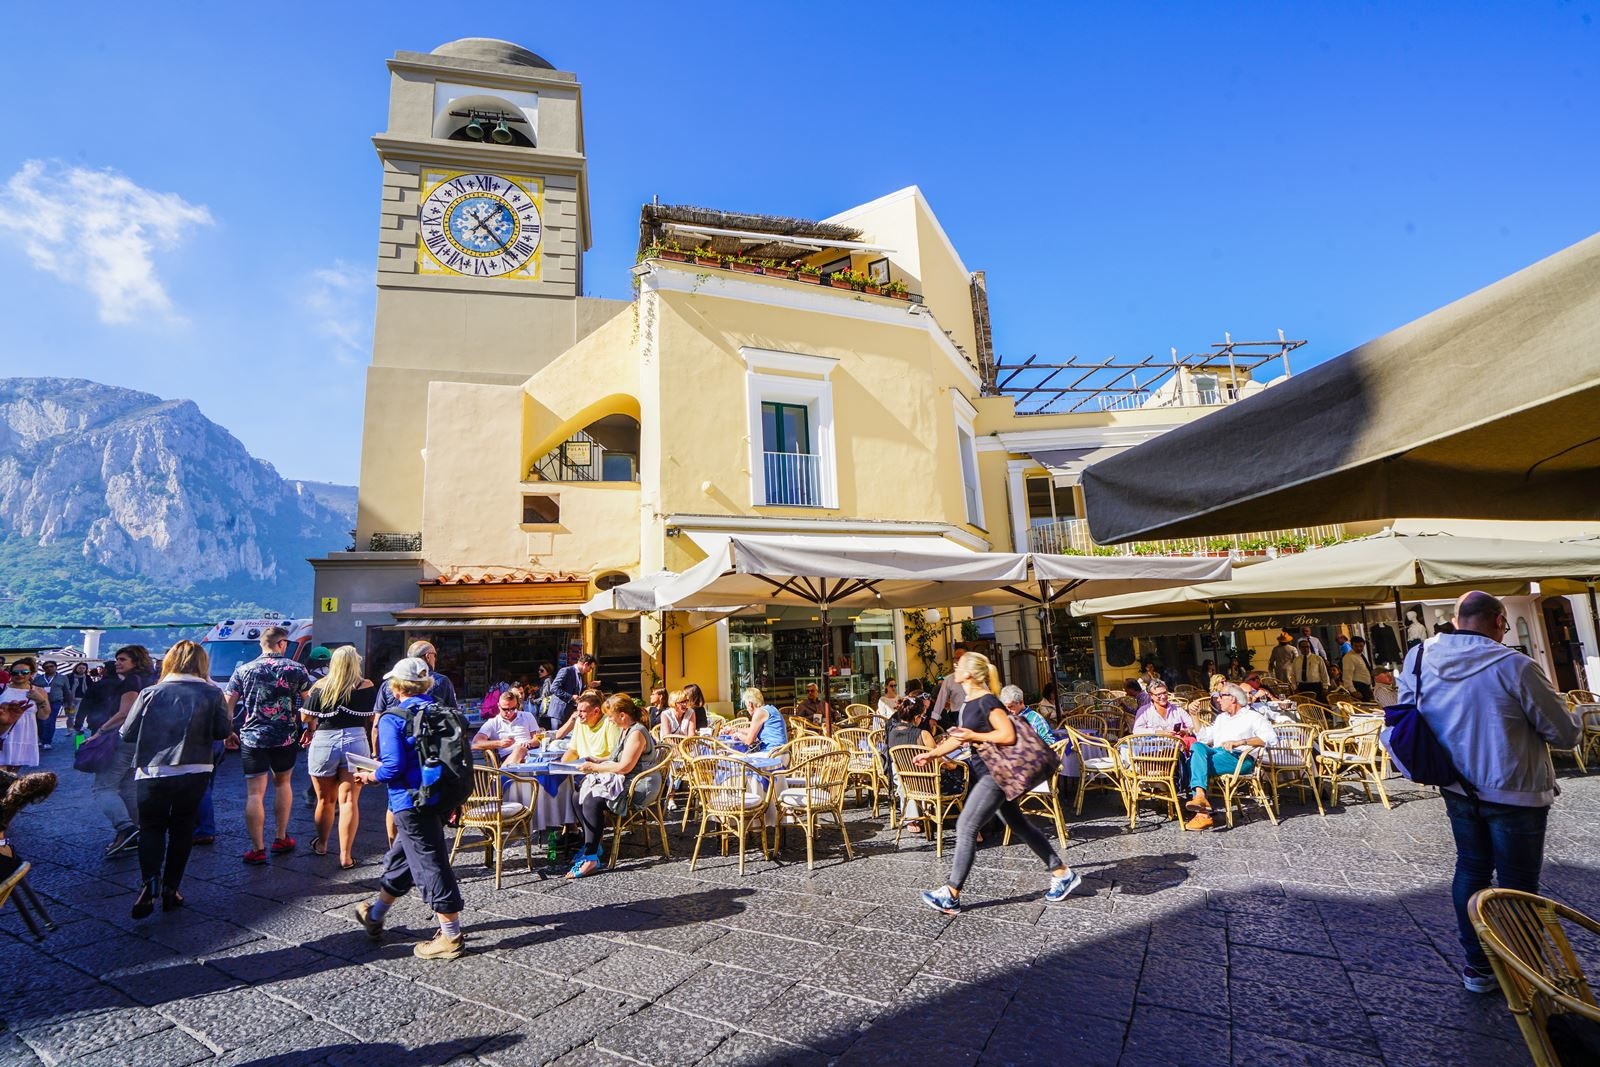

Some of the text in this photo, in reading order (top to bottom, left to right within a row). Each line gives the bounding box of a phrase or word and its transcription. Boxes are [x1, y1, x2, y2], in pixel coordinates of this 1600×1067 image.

[448, 178, 466, 196] XI
[475, 175, 493, 192] XII
[502, 184, 513, 197] I
[429, 193, 450, 208] X
[516, 202, 534, 212] II
[422, 215, 442, 226] IX
[521, 224, 540, 233] III
[426, 234, 448, 256] VIII
[513, 240, 534, 258] IIII
[445, 250, 464, 271] VII
[474, 258, 489, 275] VI
[325, 598, 333, 611] i
[1232, 617, 1279, 629] Piccolo
[1291, 614, 1321, 625] Bar
